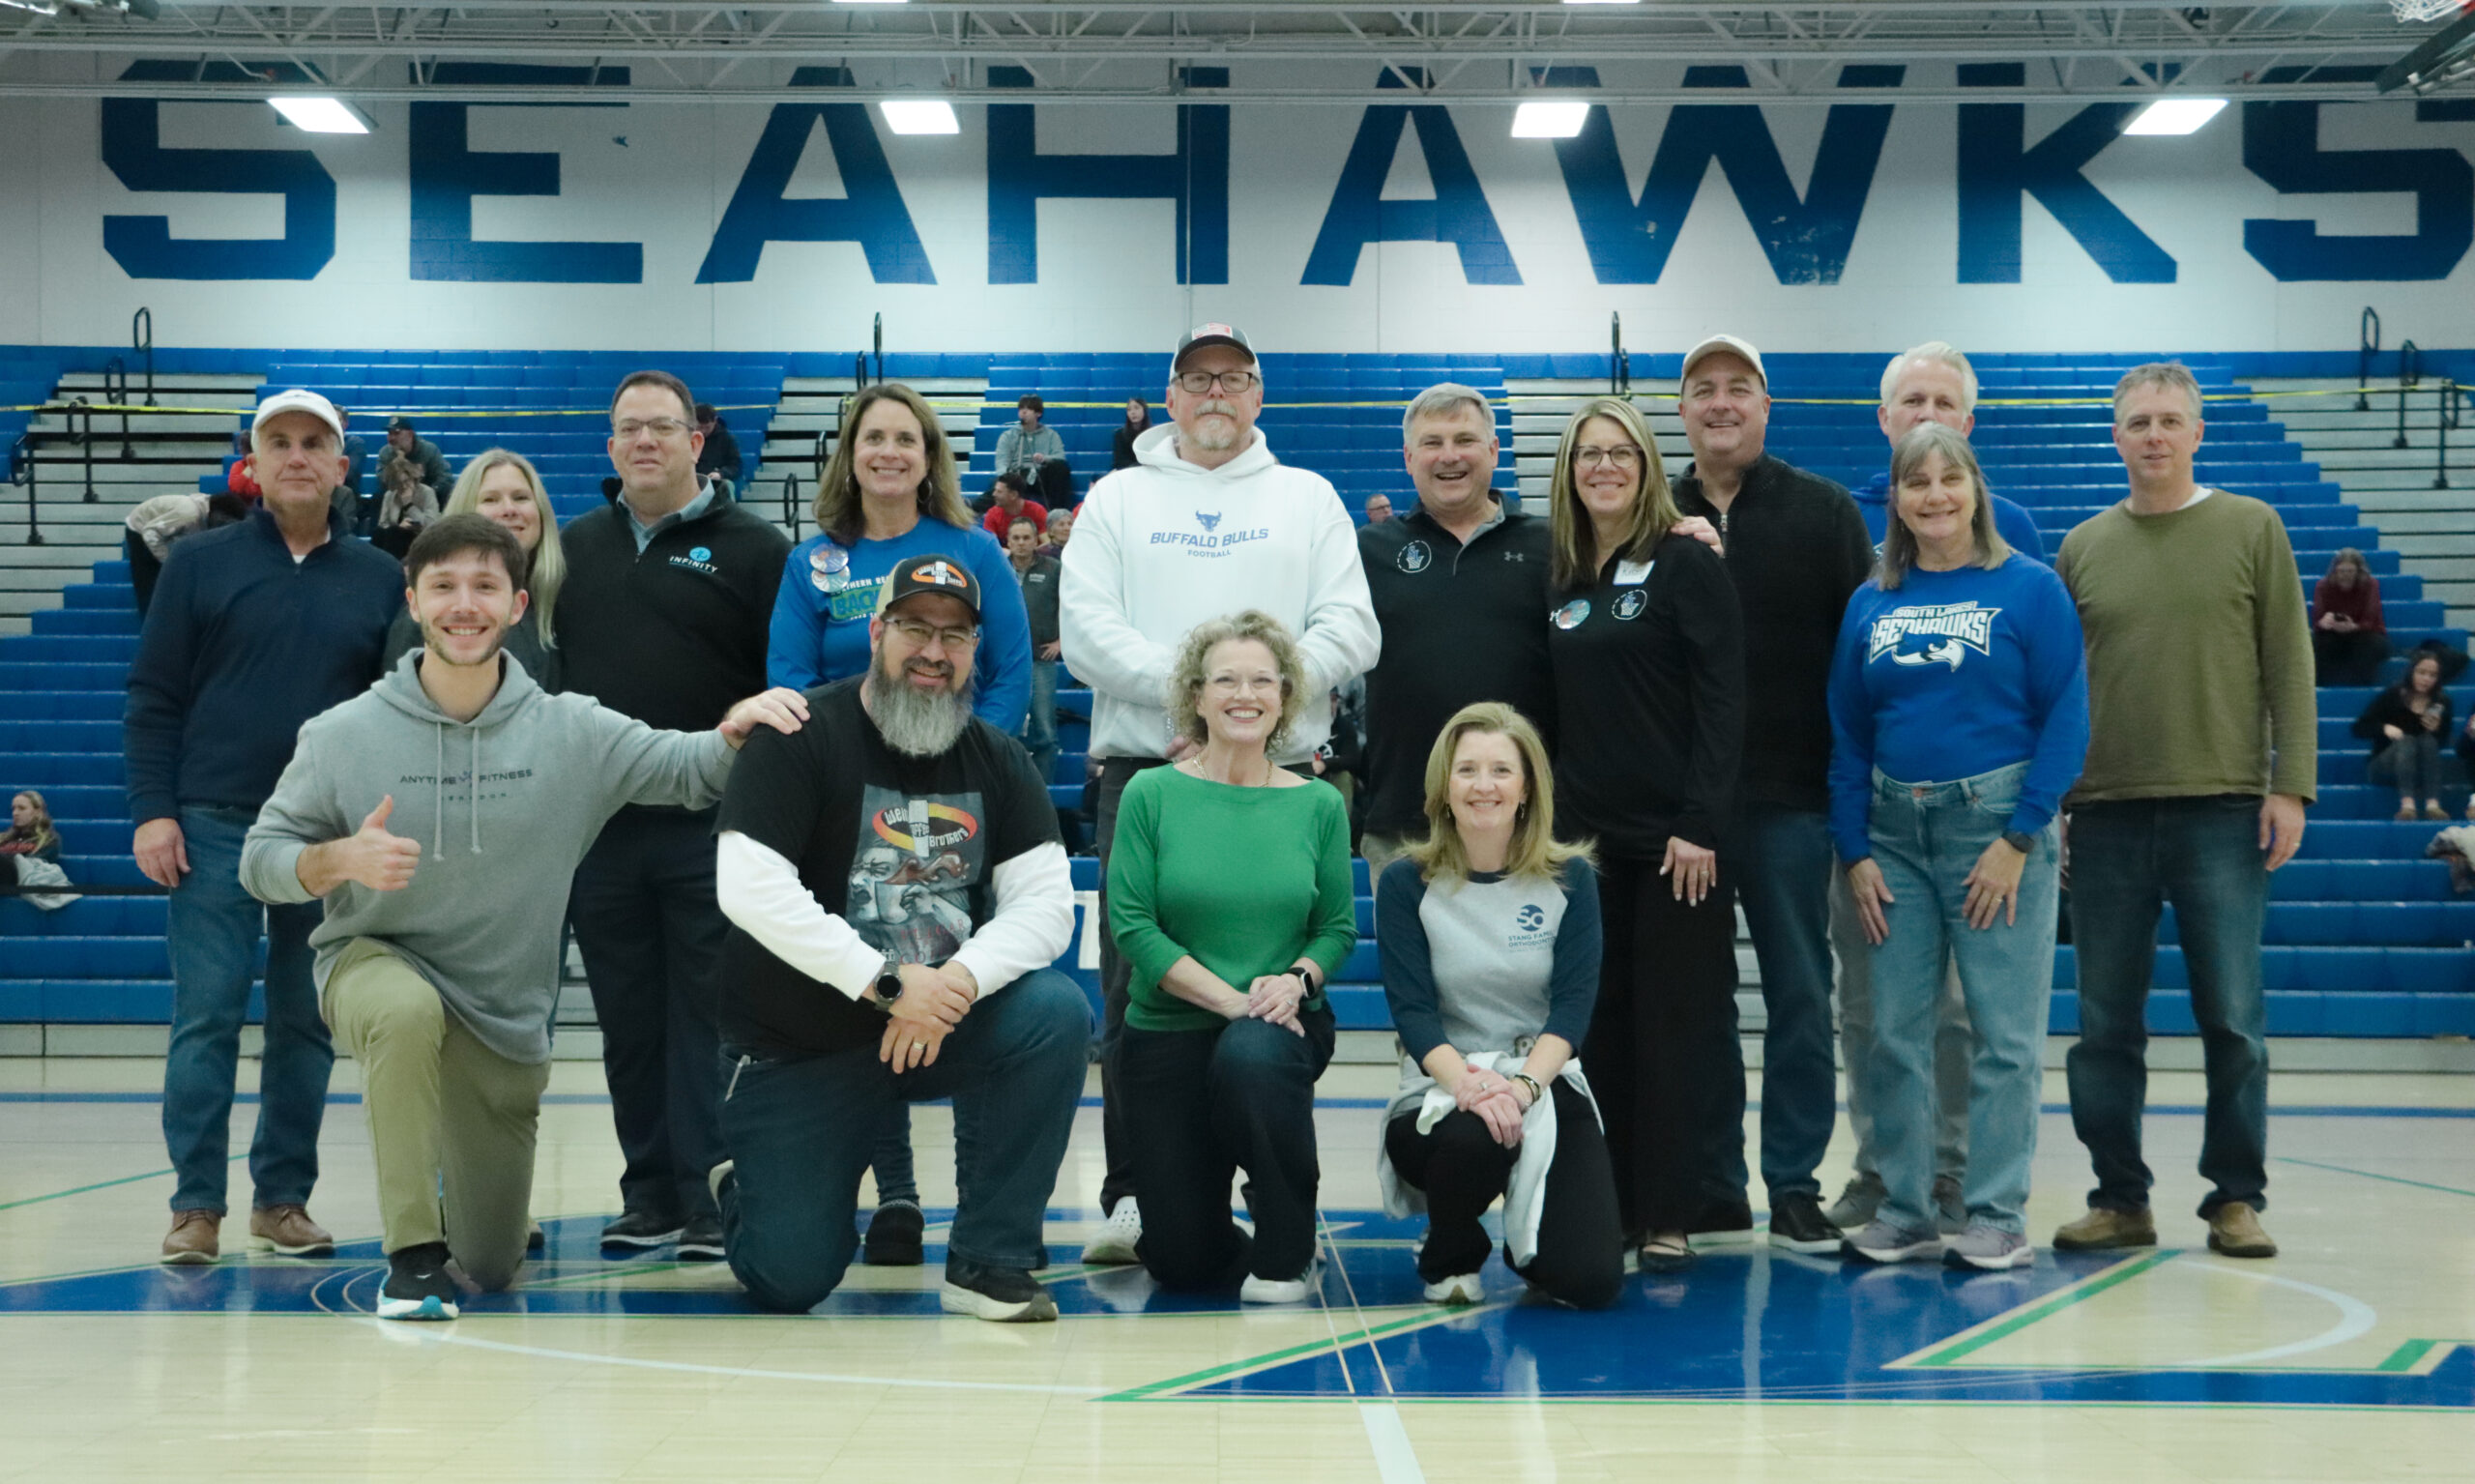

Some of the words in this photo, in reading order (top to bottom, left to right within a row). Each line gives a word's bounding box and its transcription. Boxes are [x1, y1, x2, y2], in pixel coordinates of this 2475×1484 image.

[102, 59, 2474, 285] SEAHAWKS
[1150, 532, 1218, 548] BUFFALO
[1221, 528, 1268, 547] BULLS
[1187, 549, 1231, 558] FOOTBALL
[669, 555, 718, 573] INFINITY
[1895, 607, 1935, 619] SOUTH
[479, 769, 533, 783] FITNESS
